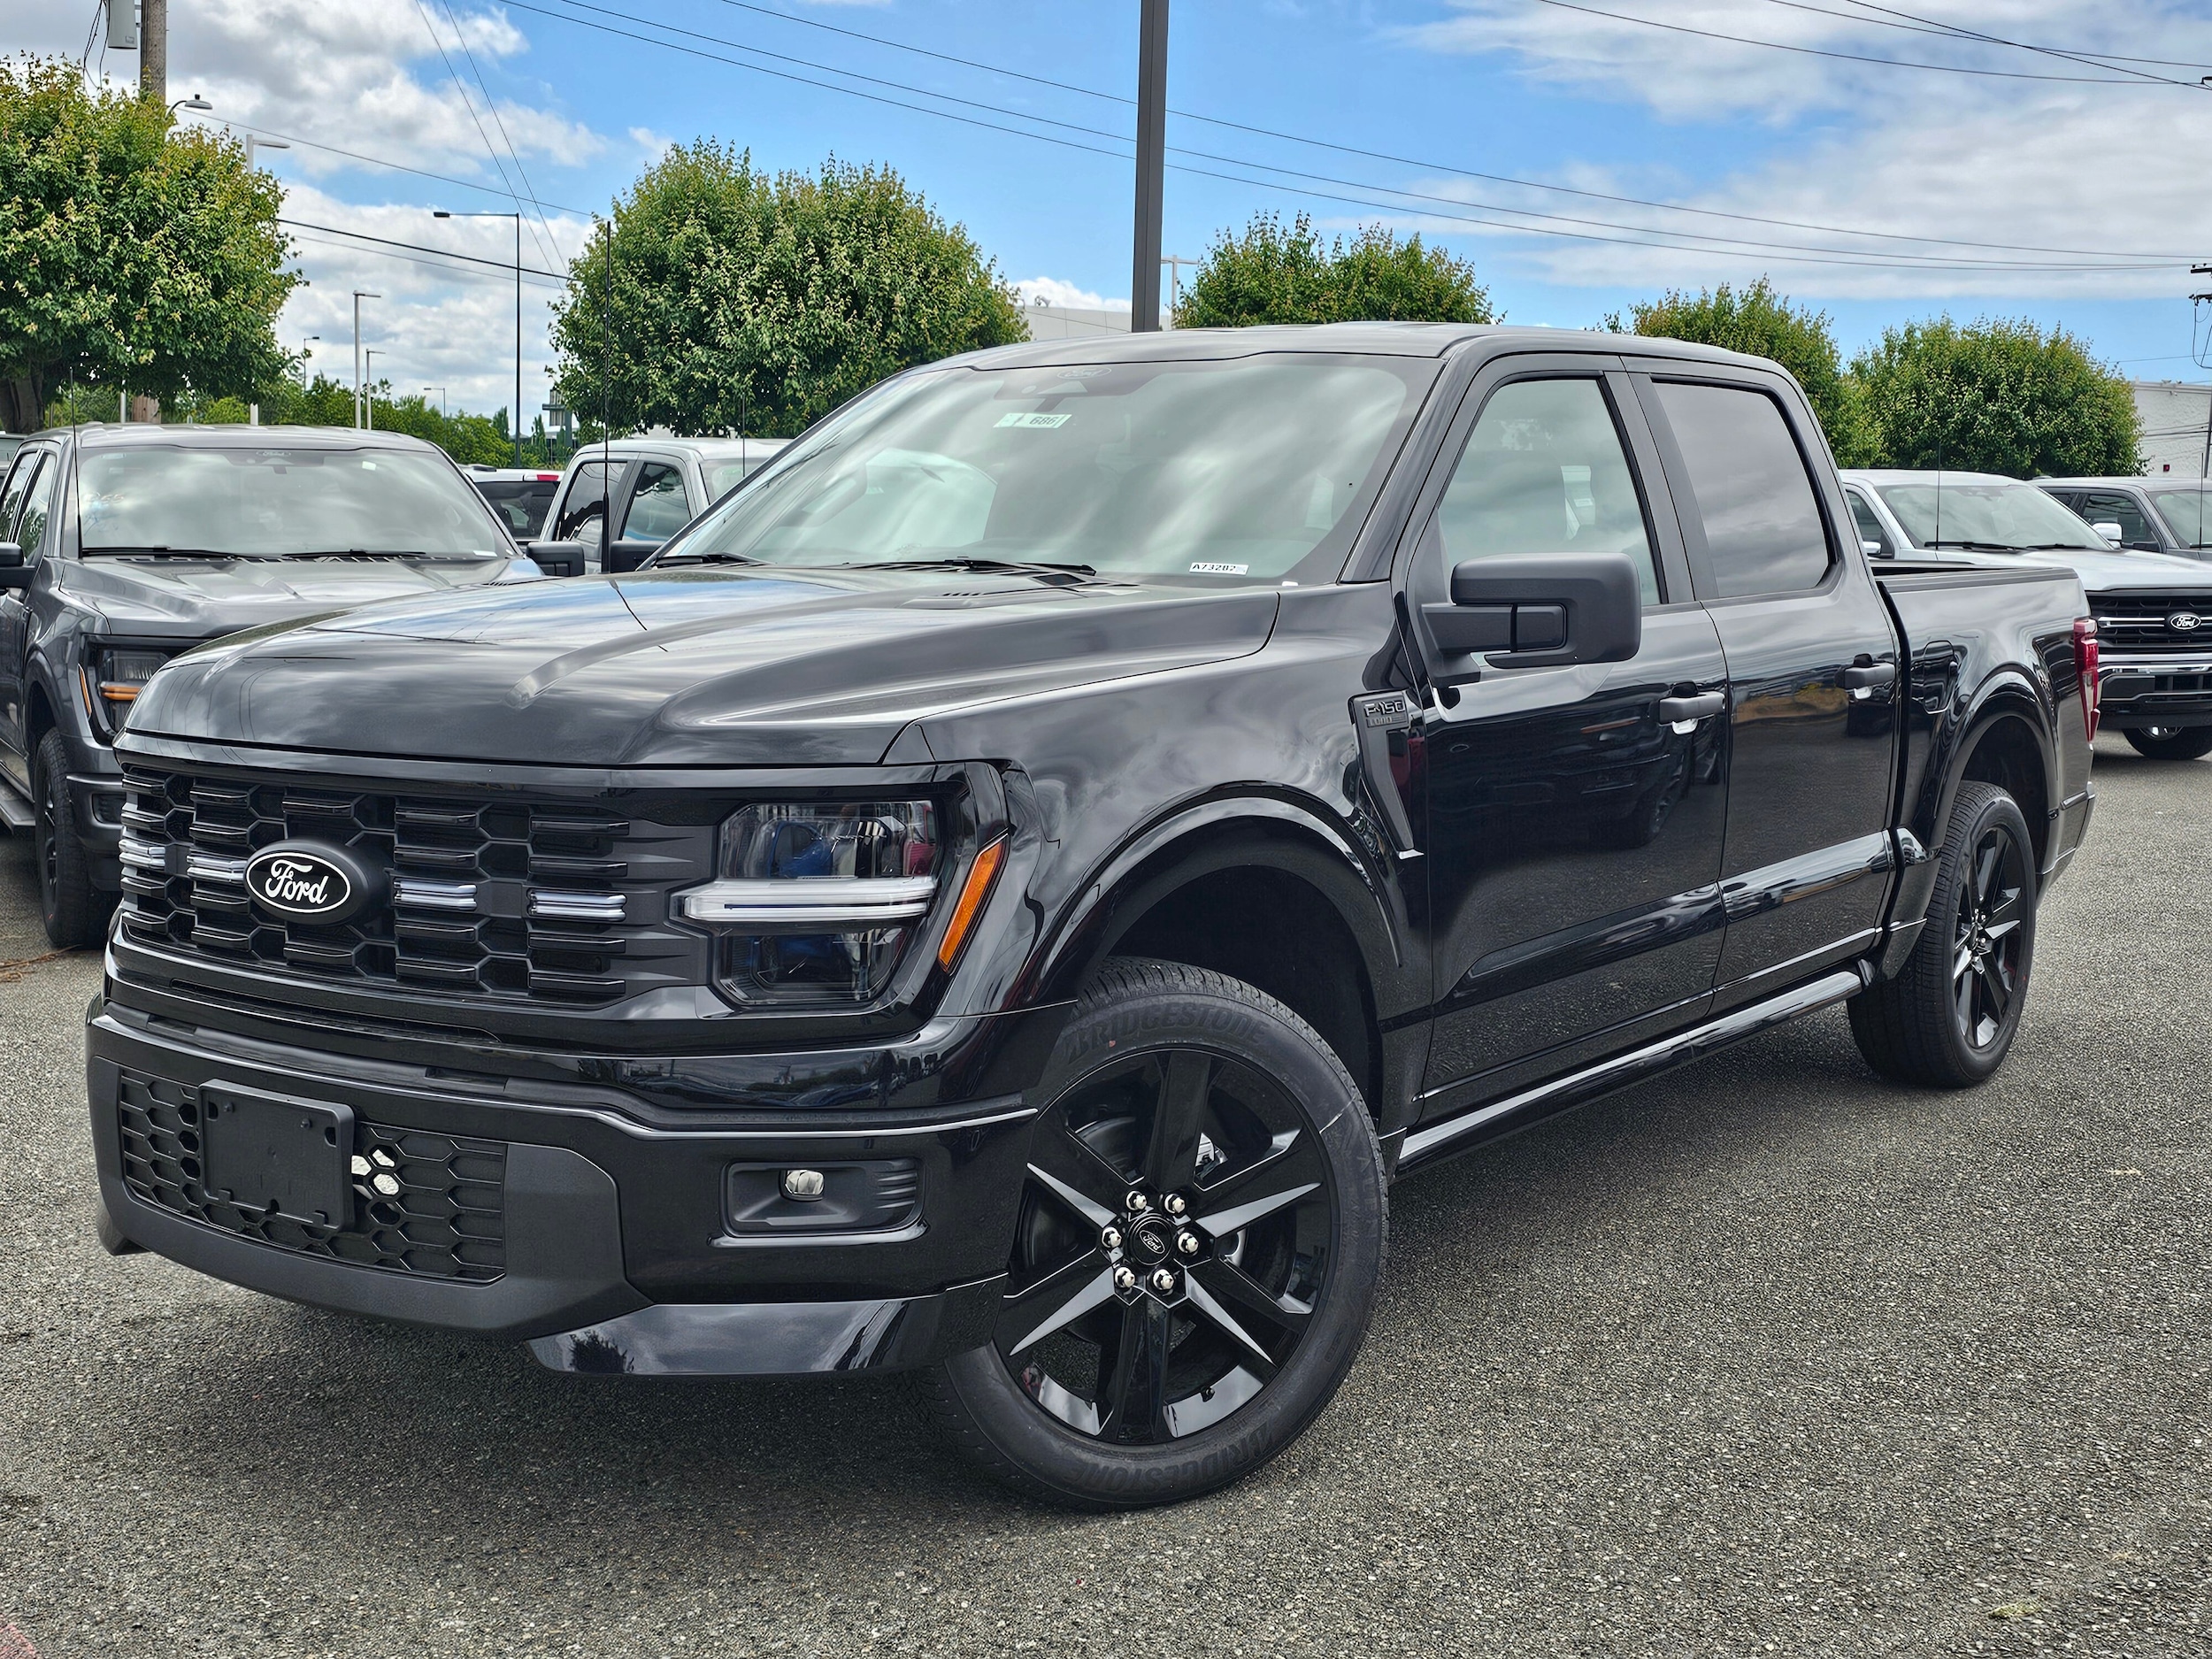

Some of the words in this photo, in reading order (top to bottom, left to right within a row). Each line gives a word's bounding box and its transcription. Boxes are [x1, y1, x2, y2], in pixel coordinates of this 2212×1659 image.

[2177, 616, 2196, 626] Ford
[1363, 701, 1406, 717] F-150
[265, 859, 329, 904] Ford
[1142, 1233, 1162, 1250] Ford
